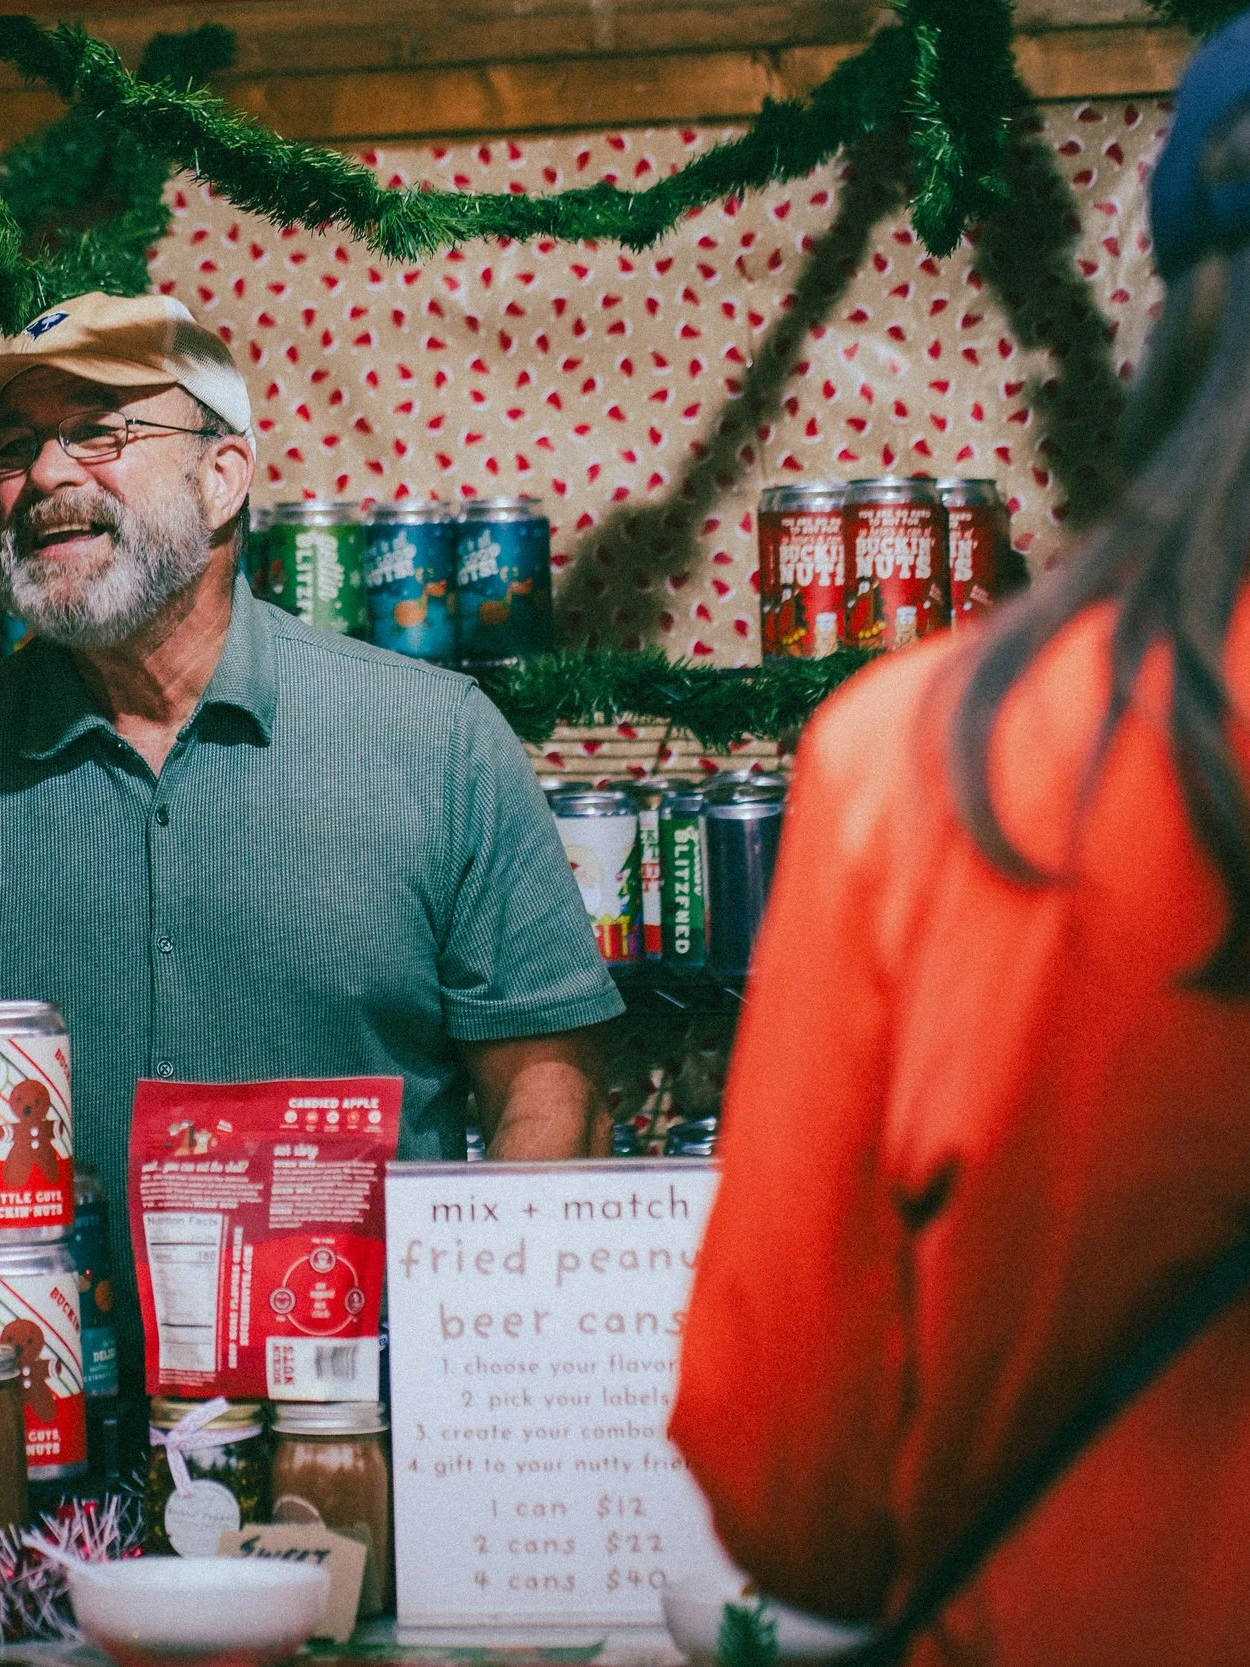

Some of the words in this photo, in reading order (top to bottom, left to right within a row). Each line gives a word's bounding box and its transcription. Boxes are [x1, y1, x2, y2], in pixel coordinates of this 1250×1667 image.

[856, 555, 932, 580] NUTS
[288, 1097, 340, 1109] CANDIED
[342, 1097, 380, 1109] APPLE
[432, 1194, 500, 1223] mix
[563, 1184, 690, 1221] match
[146, 1216, 185, 1226] Nutrition
[189, 1216, 219, 1227] Facts
[232, 1225, 244, 1264] ONLINE
[398, 1238, 528, 1280] fried
[555, 1245, 703, 1288] peanu
[230, 1264, 241, 1310] FLAVORS
[229, 1310, 239, 1341] MORE
[439, 1301, 550, 1342] beer
[578, 1308, 688, 1336] cans
[282, 1344, 296, 1386] NUTS
[464, 1357, 540, 1377] choose
[550, 1361, 599, 1385] your
[608, 1355, 677, 1376] flavor
[488, 1387, 534, 1412] pick
[543, 1393, 592, 1417] your
[25, 1441, 61, 1457] NUTS
[440, 1423, 513, 1441] create
[521, 1427, 569, 1450] your
[581, 1422, 655, 1441] combo
[434, 1456, 475, 1479] gift
[484, 1457, 506, 1474] to
[516, 1460, 564, 1481] your
[574, 1456, 632, 1479] nutty
[491, 1499, 499, 1518] 1
[516, 1501, 567, 1519] can
[597, 1495, 648, 1520] $12
[474, 1534, 489, 1554] 2
[508, 1537, 577, 1556] cans
[605, 1532, 665, 1556] $22
[473, 1571, 490, 1590] 4
[508, 1573, 577, 1592] cans
[606, 1569, 670, 1594] $40
